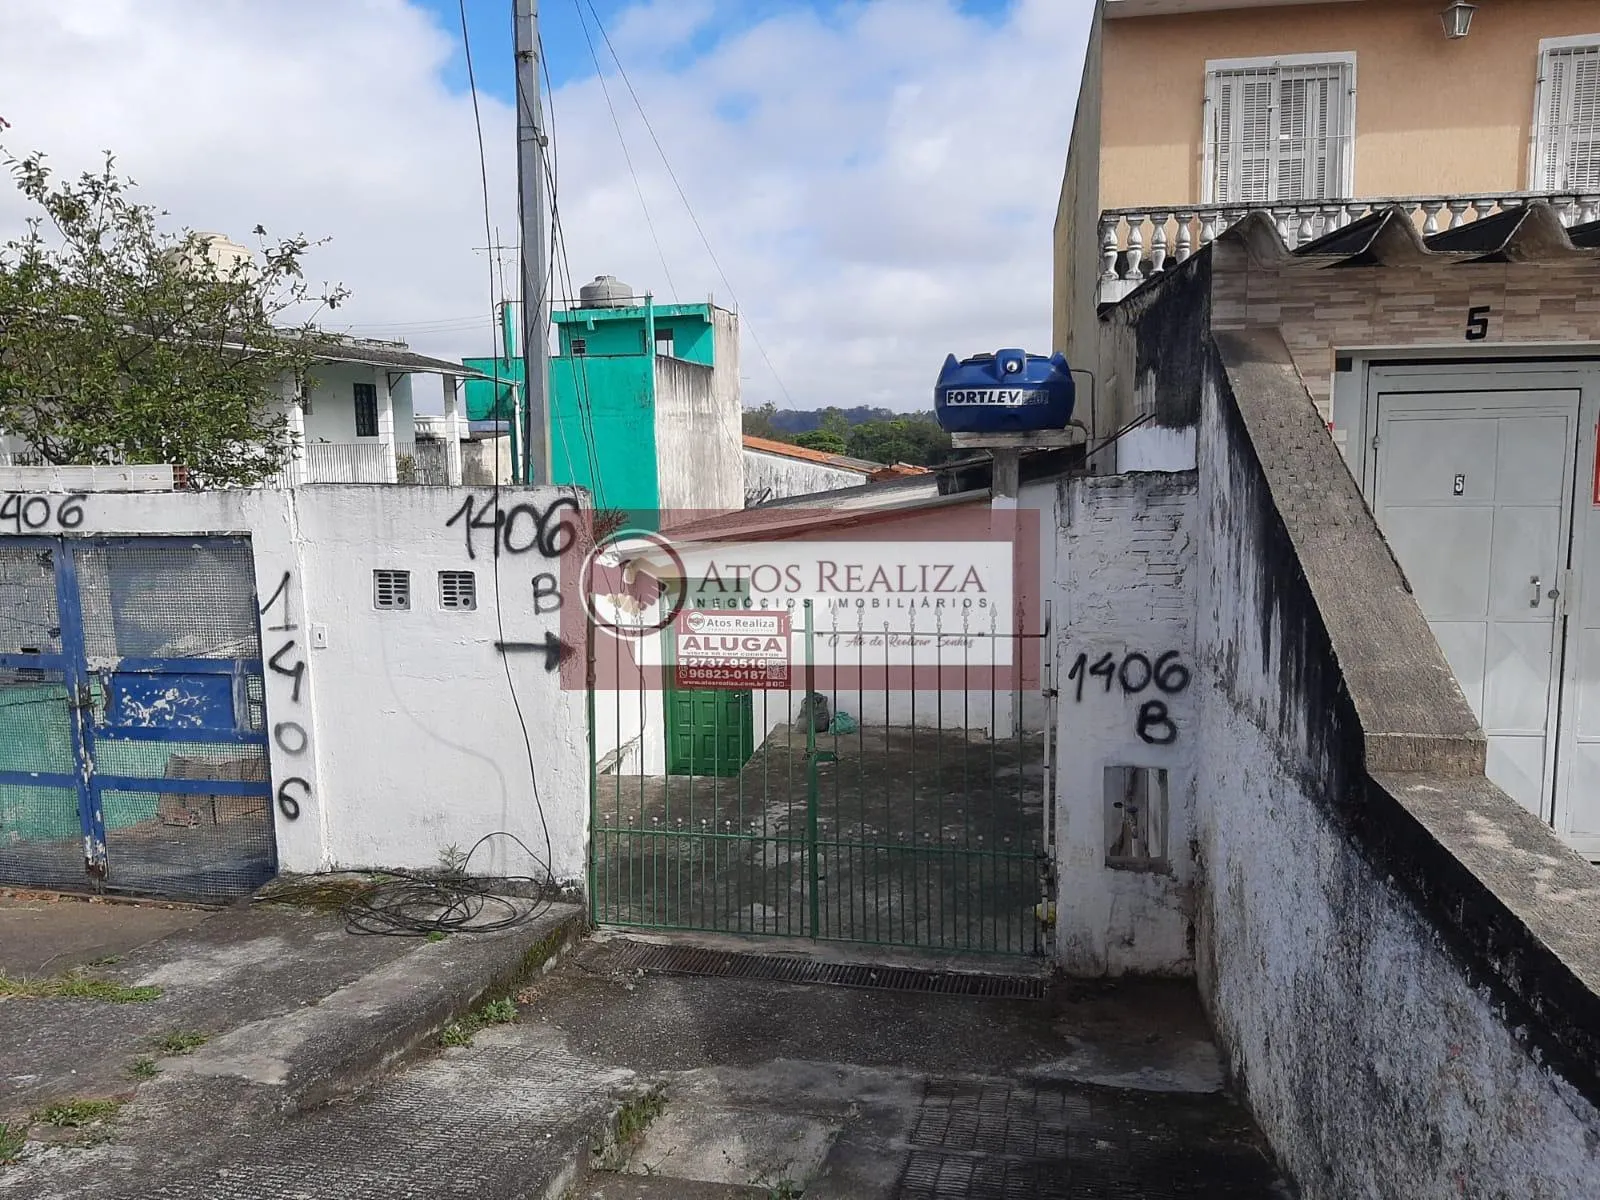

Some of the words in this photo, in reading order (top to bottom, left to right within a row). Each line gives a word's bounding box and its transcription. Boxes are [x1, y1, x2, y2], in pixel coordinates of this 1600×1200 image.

[1466, 306, 1490, 340] 5
[947, 390, 1021, 404] FORTLEV
[1455, 476, 1464, 492] 5
[446, 495, 580, 559] 1406
[531, 572, 564, 615] B
[706, 618, 732, 628] Atos
[734, 618, 775, 629] Realiza
[682, 636, 783, 652] ALUGA
[688, 657, 767, 669] 2737-9516
[688, 668, 767, 680] 96823-0187
[1068, 650, 1191, 702] 1406
[260, 571, 311, 821] 1406
